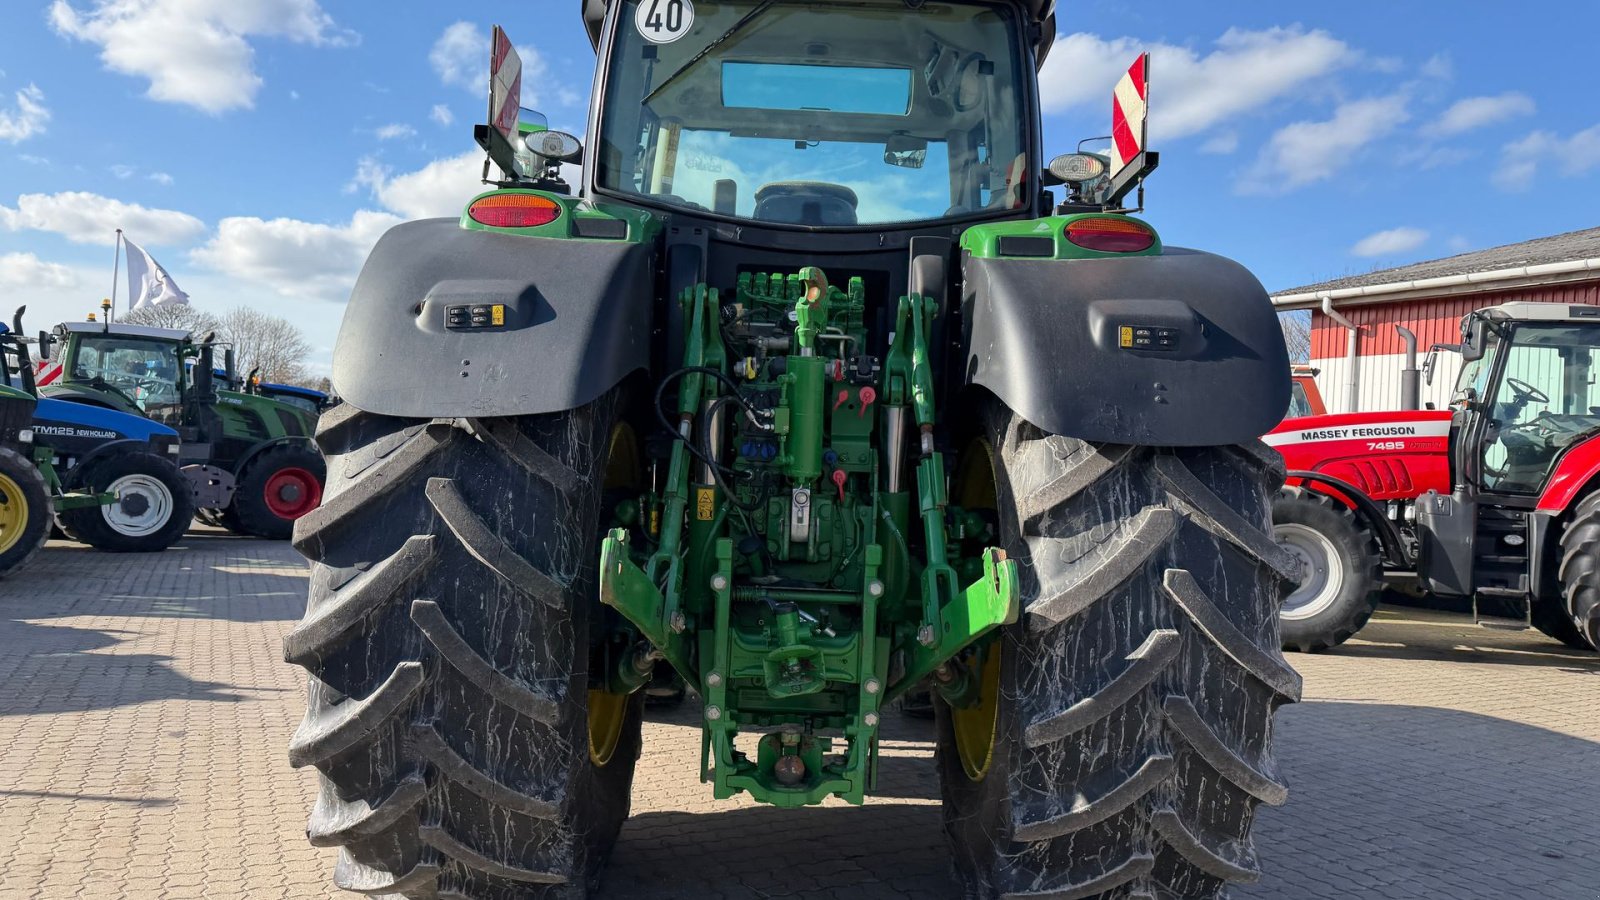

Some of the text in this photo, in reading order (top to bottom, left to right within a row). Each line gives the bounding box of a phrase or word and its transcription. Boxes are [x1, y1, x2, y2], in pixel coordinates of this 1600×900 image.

[645, 0, 683, 32] 40
[32, 425, 116, 438] TM125 NEW HOLLAND
[1301, 426, 1416, 441] MASSEY FERGUSON
[1366, 441, 1405, 451] 7495
